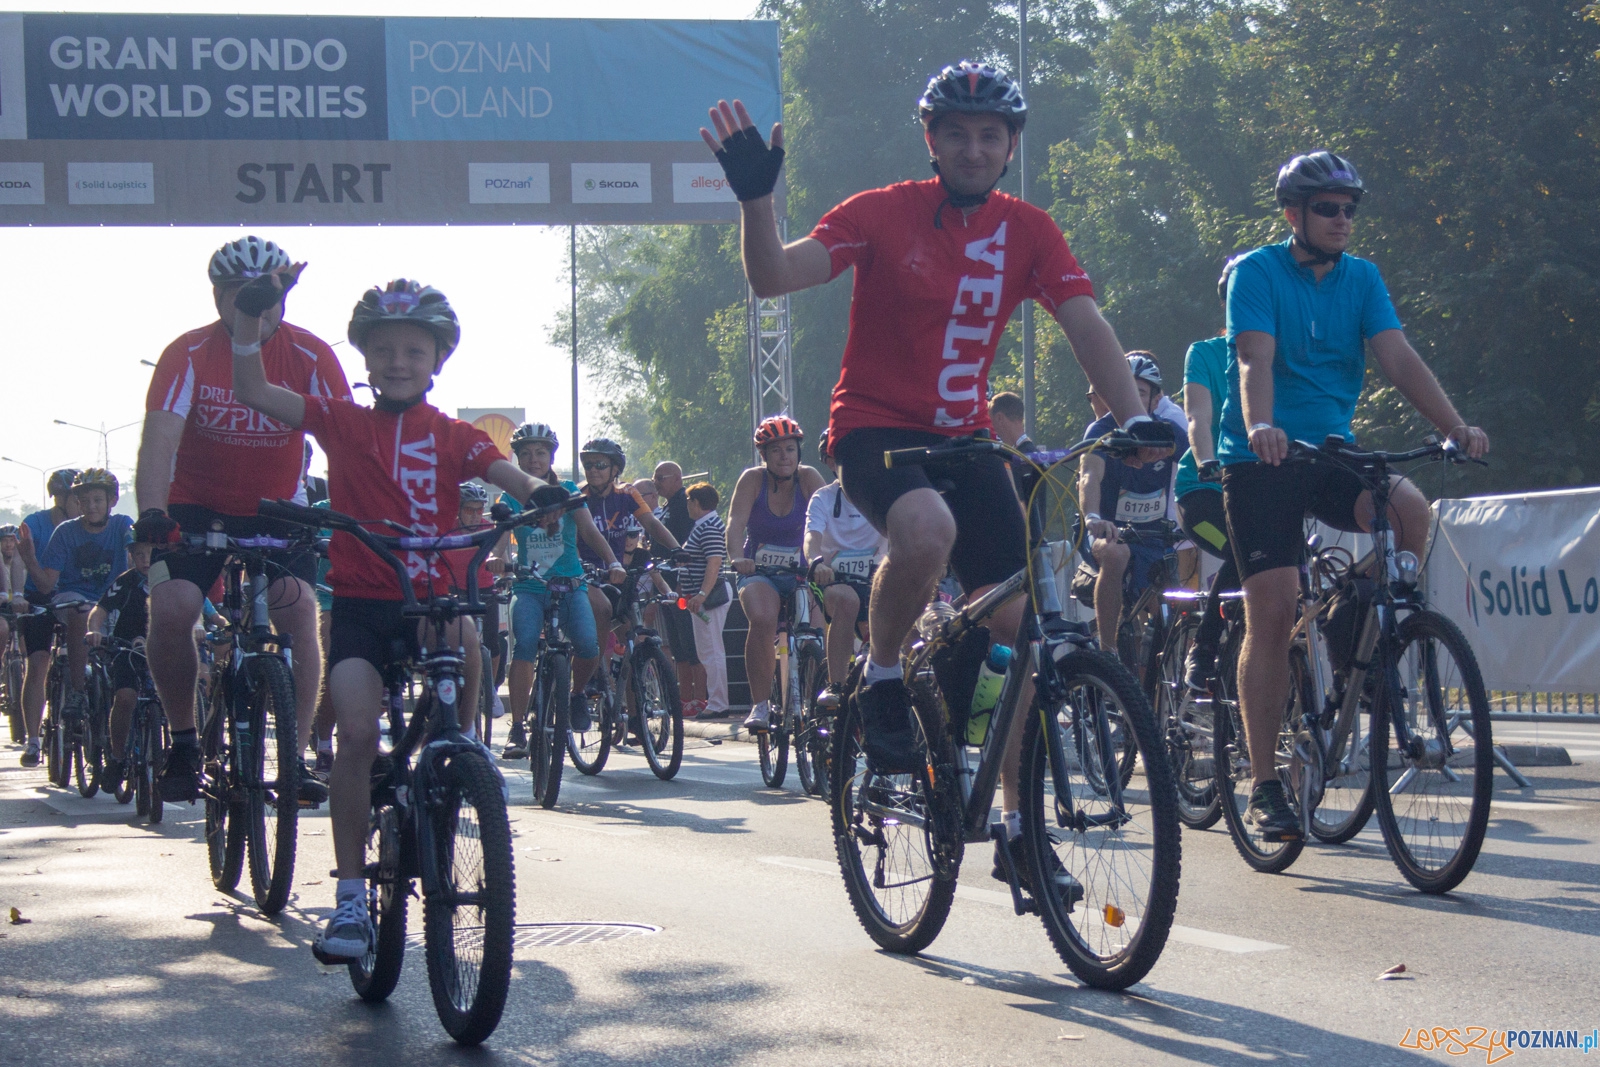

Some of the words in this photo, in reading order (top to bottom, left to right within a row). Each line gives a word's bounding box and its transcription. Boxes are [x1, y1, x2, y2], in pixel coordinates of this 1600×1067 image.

[50, 36, 177, 70] GRAN
[192, 37, 348, 72] FONDO
[409, 40, 550, 73] POZNAN
[49, 83, 212, 118] WORLD
[225, 84, 367, 119] SERIES
[411, 85, 553, 118] POLAND
[82, 180, 105, 189] Solid
[107, 181, 147, 190] Logistics
[235, 162, 391, 204] START
[199, 385, 241, 405] DRU
[1124, 500, 1160, 513] 6178-B
[530, 532, 561, 543] BIKE
[1479, 565, 1552, 616] Solid
[1558, 569, 1599, 614] Lo
